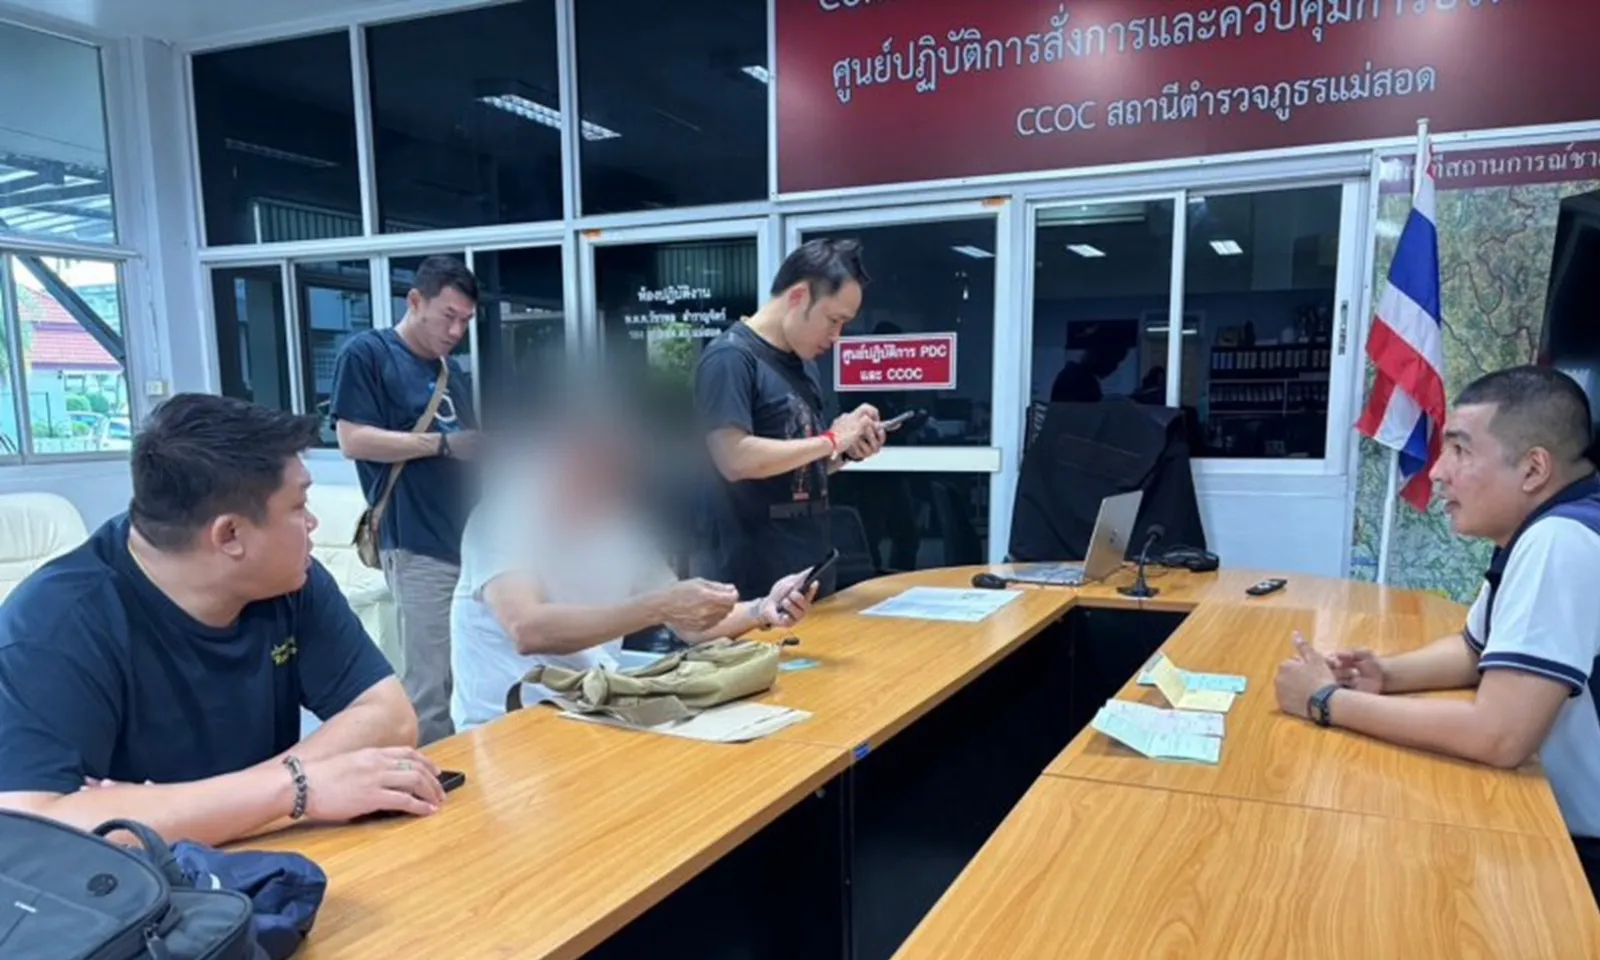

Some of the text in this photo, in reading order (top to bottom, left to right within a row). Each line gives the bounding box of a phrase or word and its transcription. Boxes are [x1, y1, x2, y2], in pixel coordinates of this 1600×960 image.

[832, 0, 1498, 103] ศูนย์ปฏิบัติการสั่งการและควบคุมก
[1016, 61, 1437, 136] CCOC สถานีตำรวจภูธรแม่สอด
[842, 344, 948, 366] ศูนย์ปฏิบัติการ PDC
[860, 367, 924, 381] และ CCOC
